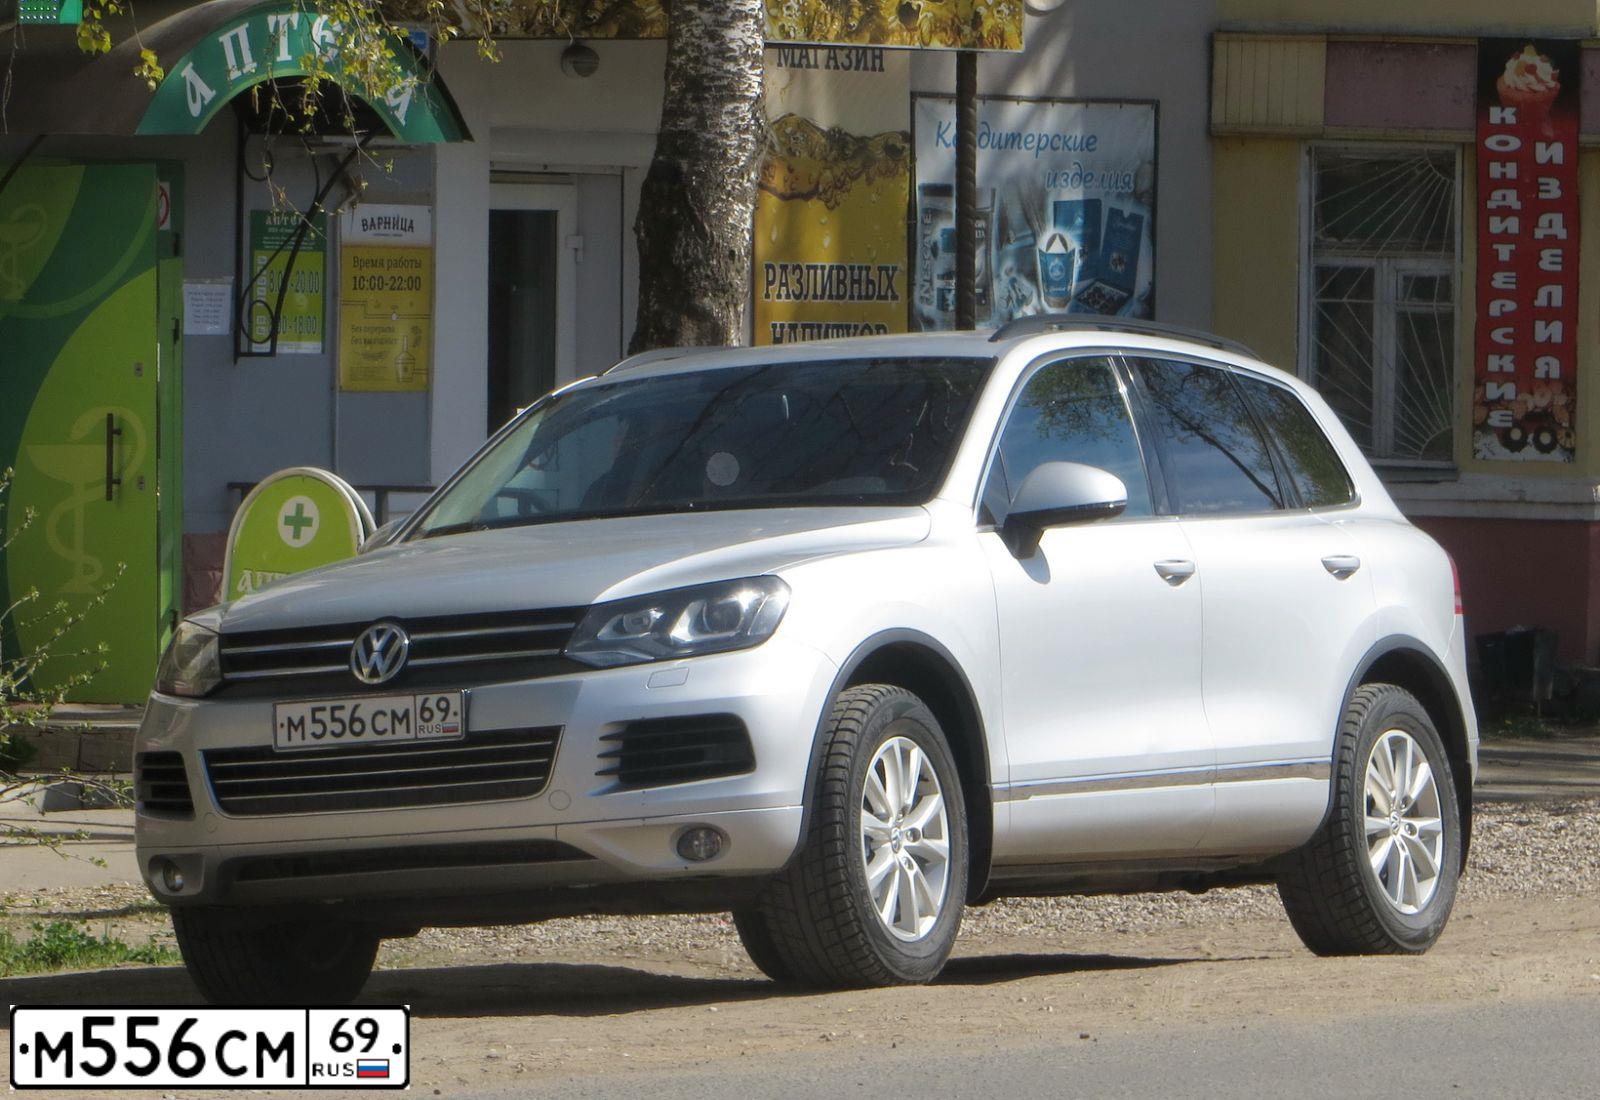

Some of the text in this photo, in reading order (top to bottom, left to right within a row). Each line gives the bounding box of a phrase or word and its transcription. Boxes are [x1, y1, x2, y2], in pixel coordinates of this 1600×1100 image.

[181, 12, 418, 126] АПТЕА
[777, 47, 885, 73] МАГАЗИН
[1046, 162, 1135, 191] изделия
[353, 256, 422, 271] Время работы
[1484, 106, 1522, 429] КОНДИТЕРСКИЕ
[1533, 141, 1568, 380] ИЗДЕЛИЯ
[764, 264, 899, 301] РАЗЛИВНЫХ
[287, 696, 450, 742] М556СМ 69
[418, 723, 441, 735] RUS
